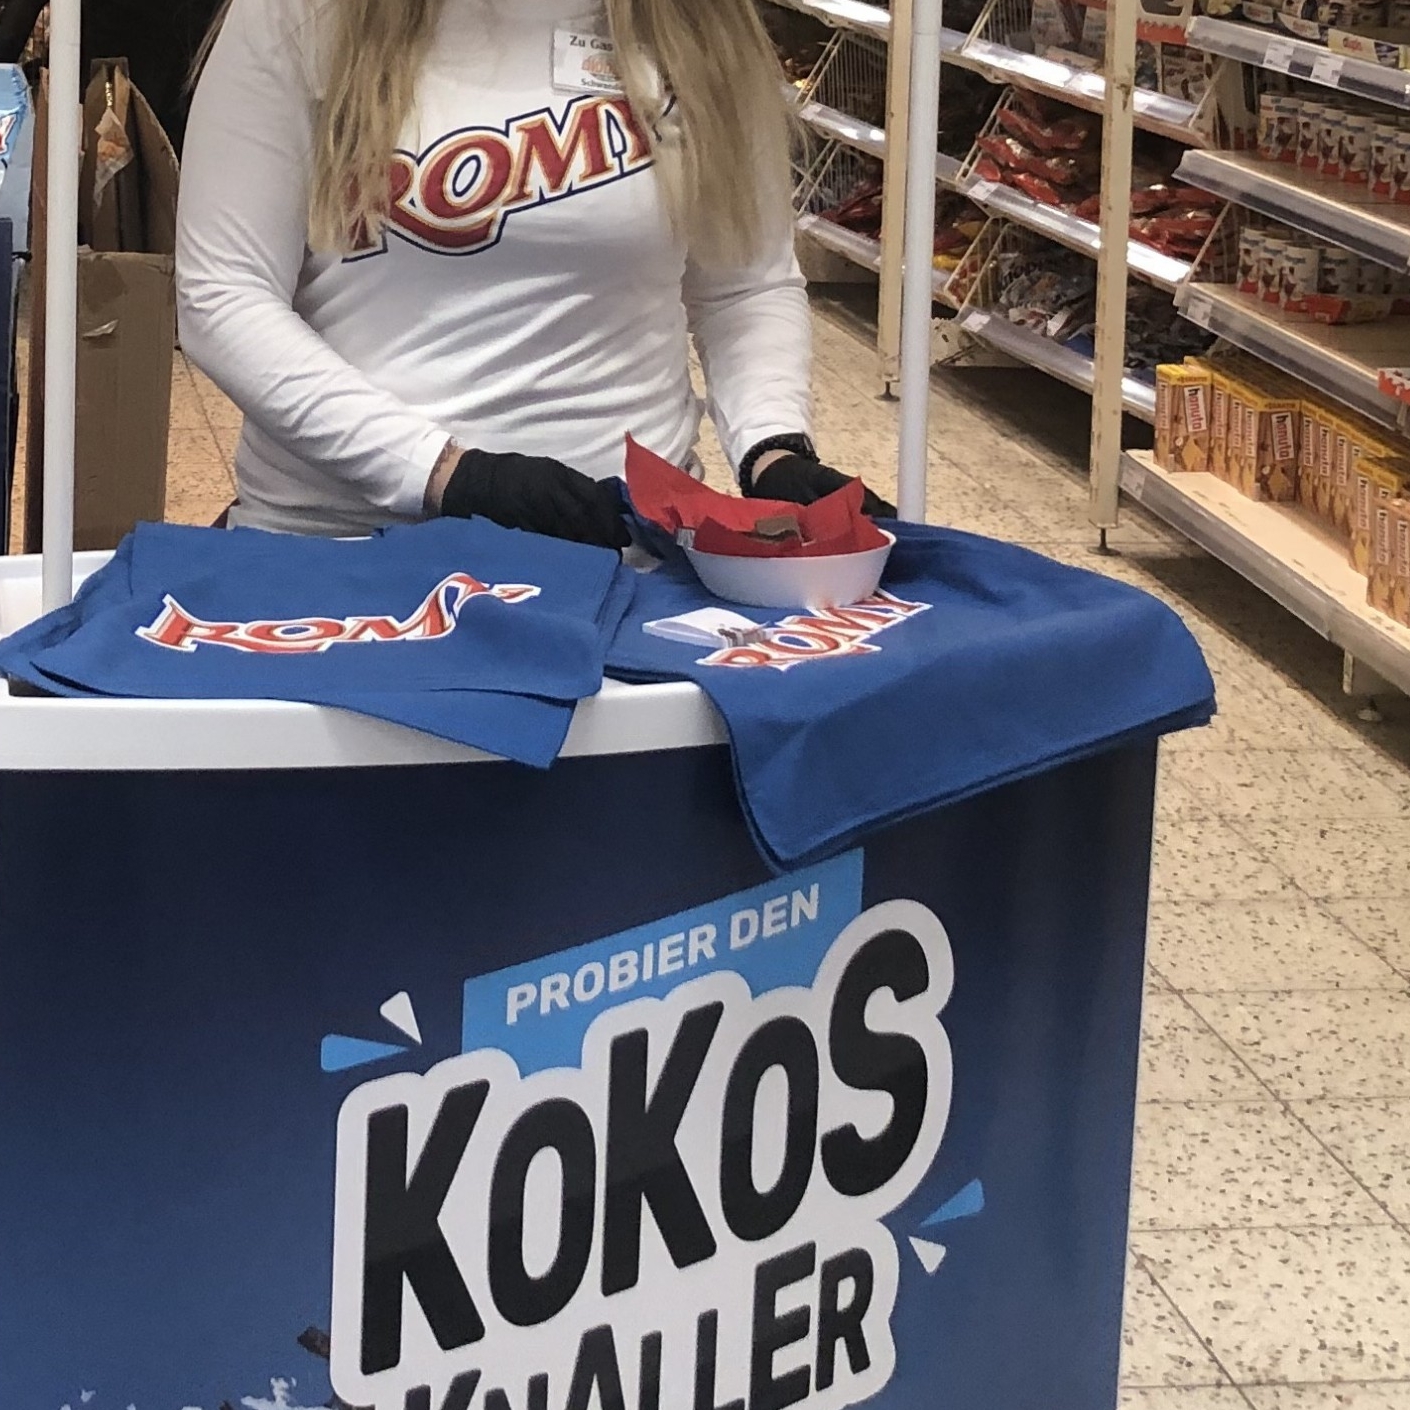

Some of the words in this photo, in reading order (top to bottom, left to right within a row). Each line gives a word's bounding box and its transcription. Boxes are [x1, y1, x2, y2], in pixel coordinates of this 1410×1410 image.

[570, 35, 586, 48] Zu
[1187, 387, 1204, 431] hanuta
[1276, 413, 1292, 459] hanuta
[506, 922, 717, 1026] PROBIER
[730, 882, 820, 951] DEN
[361, 928, 930, 1376] KOKOS
[403, 1241, 876, 1410] ALLER
